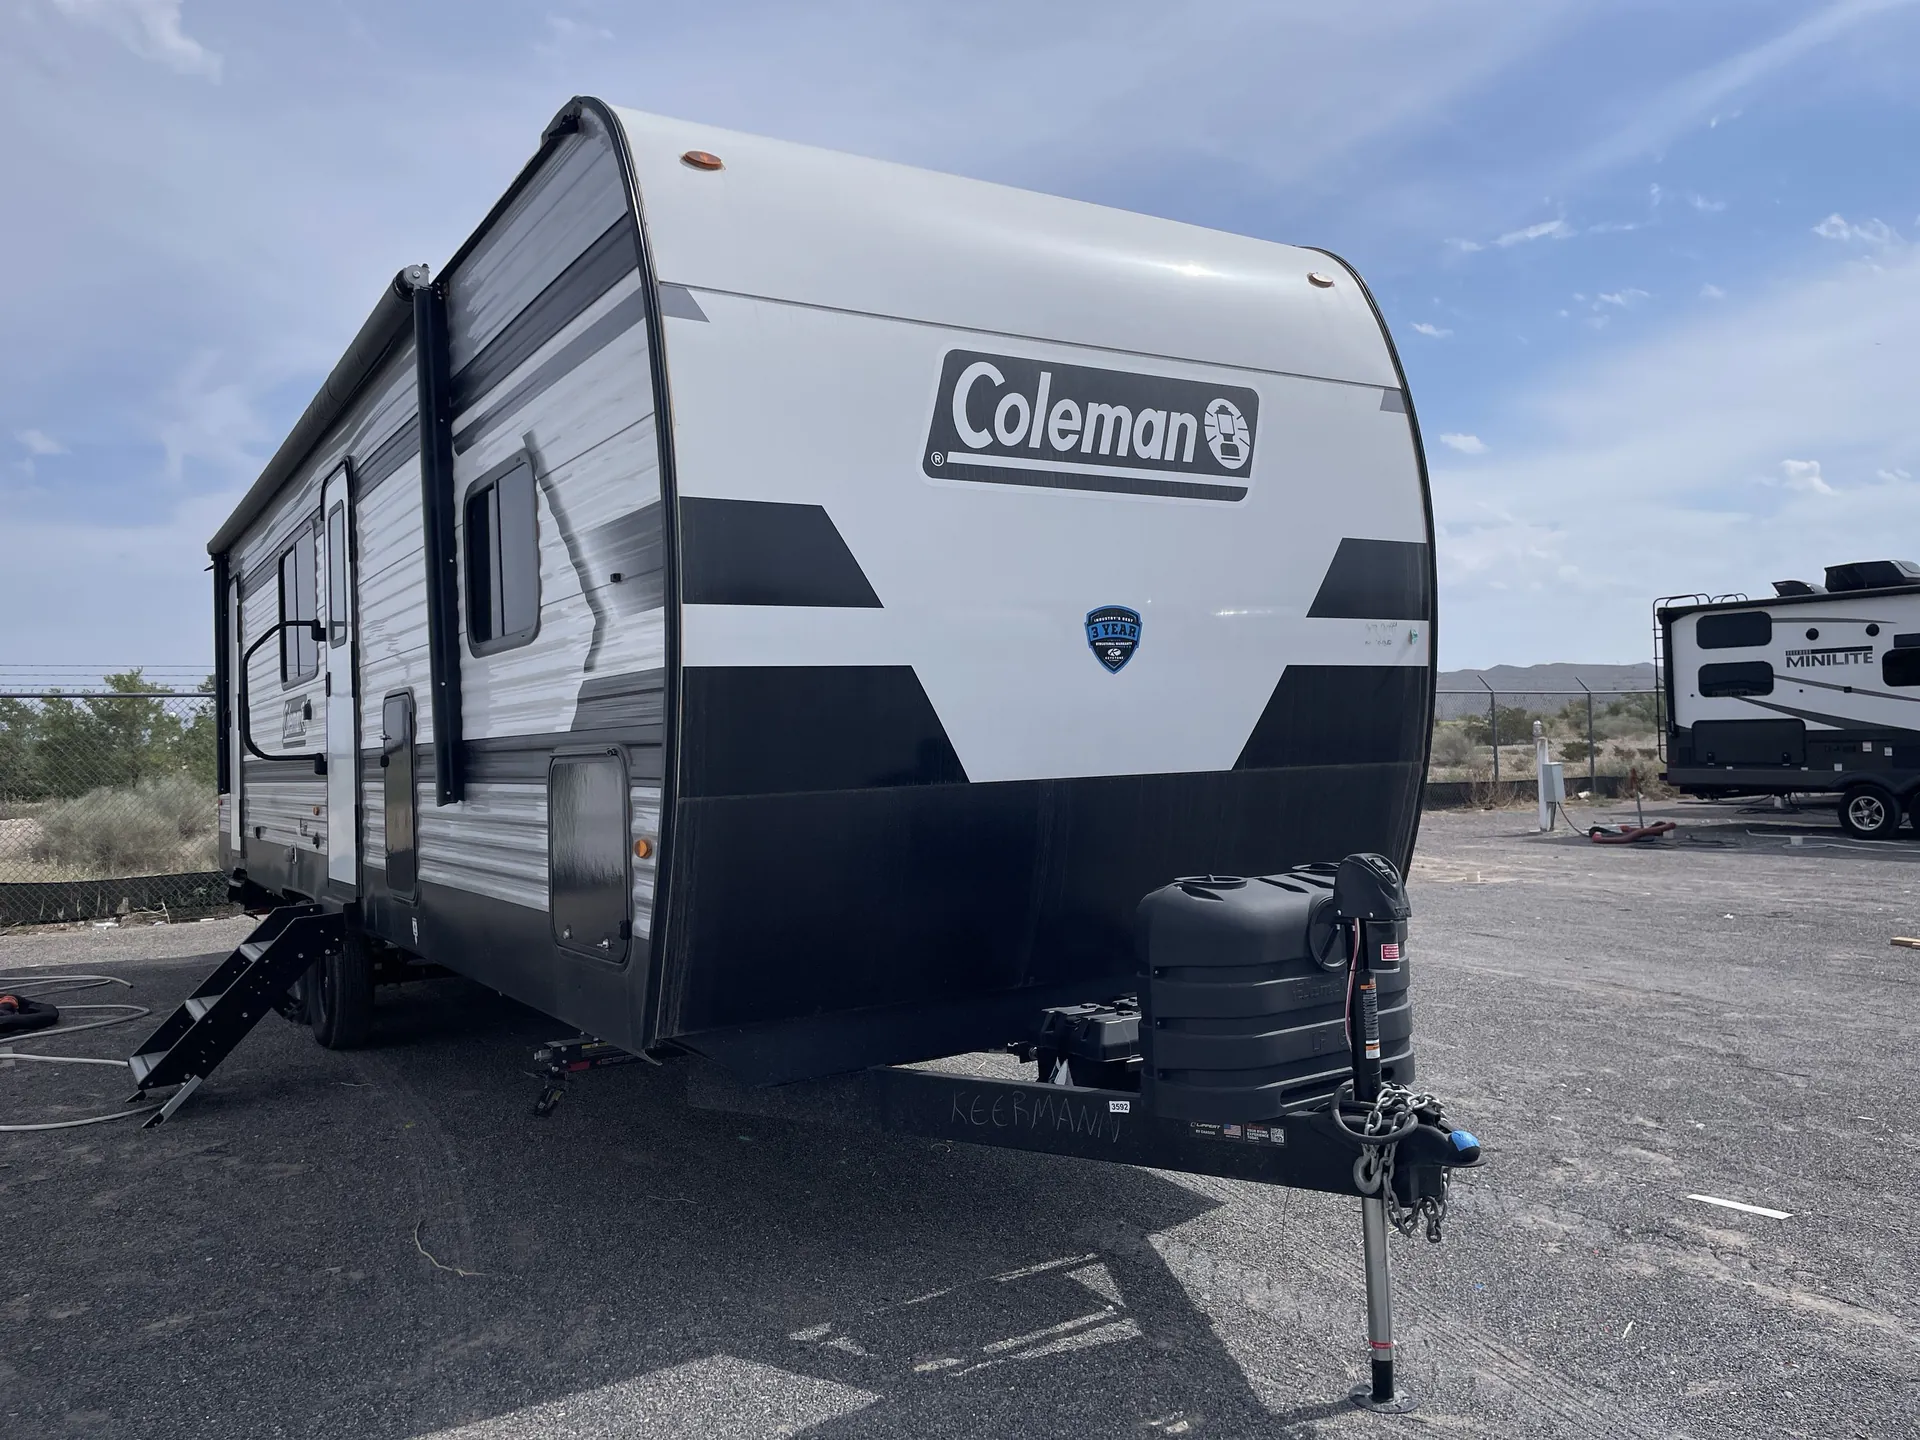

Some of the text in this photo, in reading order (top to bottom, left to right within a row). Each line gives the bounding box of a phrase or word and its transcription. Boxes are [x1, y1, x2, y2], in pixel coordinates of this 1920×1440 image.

[952, 361, 1198, 463] Coleman
[1091, 624, 1136, 638] 3 YEAR
[1786, 652, 1873, 668] MINILITE
[1111, 1103, 1129, 1112] 3592
